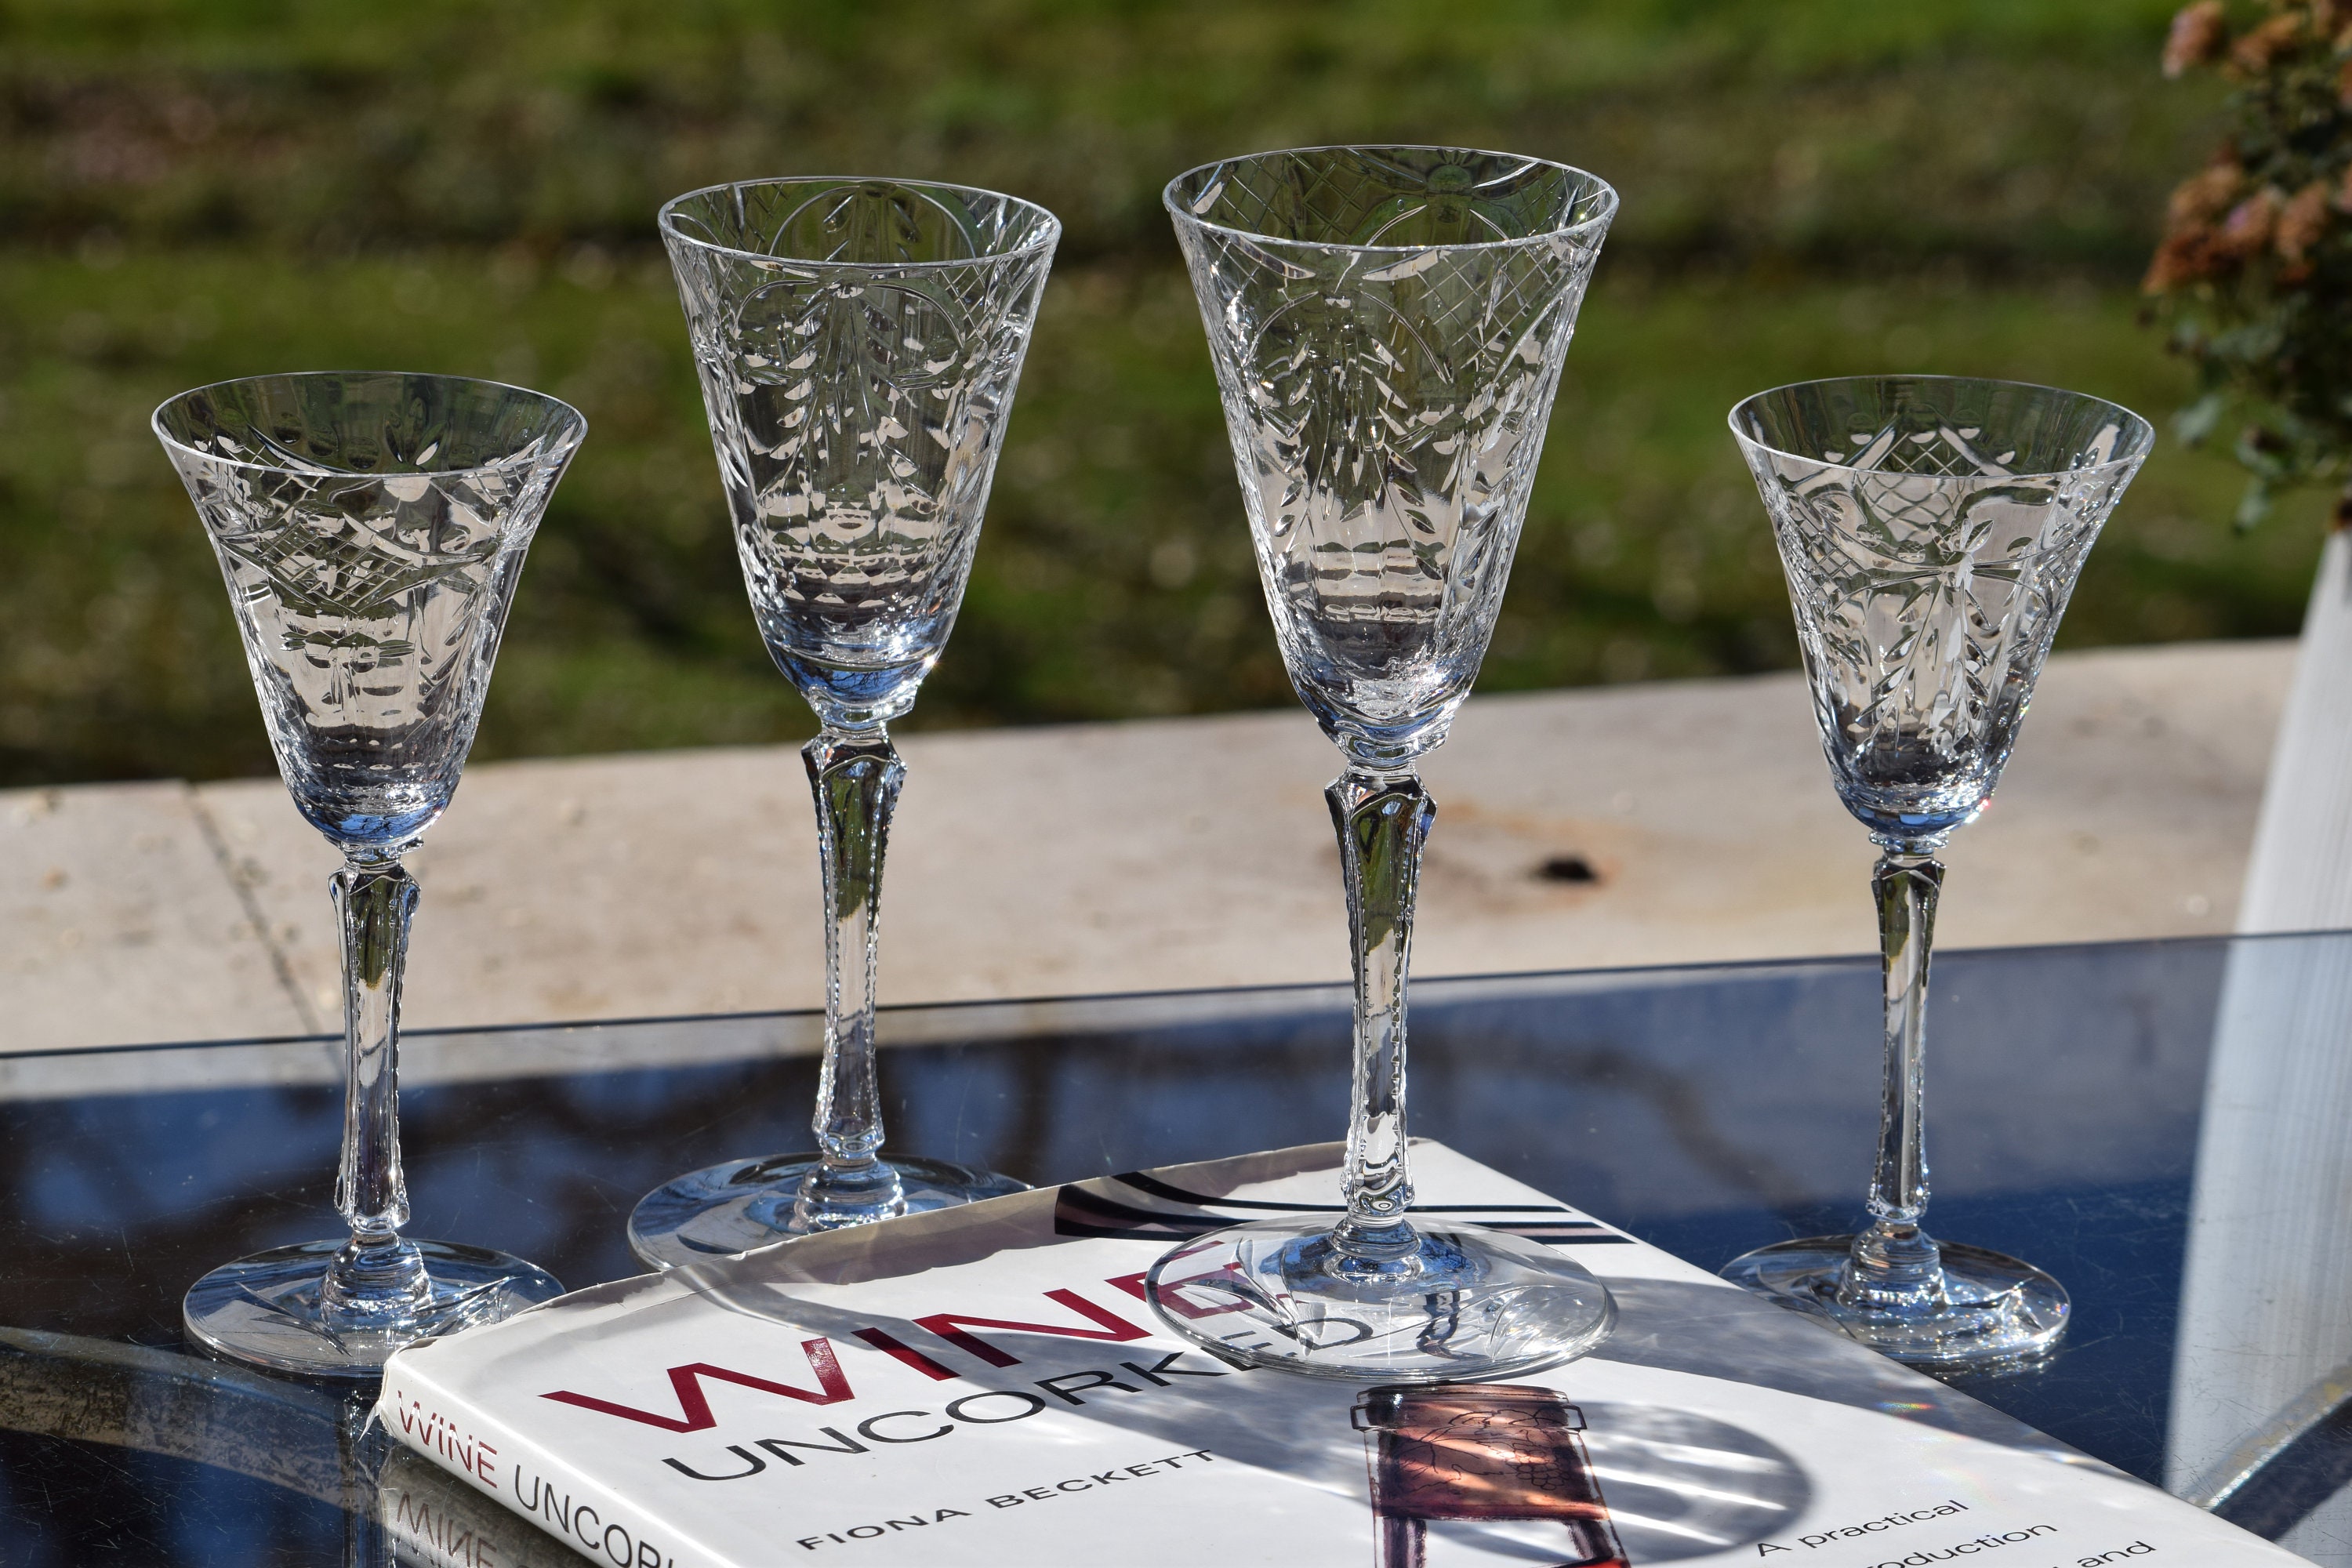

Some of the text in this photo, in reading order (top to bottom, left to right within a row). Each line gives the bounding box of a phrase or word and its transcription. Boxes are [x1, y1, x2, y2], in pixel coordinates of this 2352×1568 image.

[397, 1390, 674, 1568] WINE UNCOR
[797, 1450, 1214, 1551] FIONA BECKETT
[1757, 1499, 1969, 1557] A practical
[2078, 1541, 2157, 1568] and
